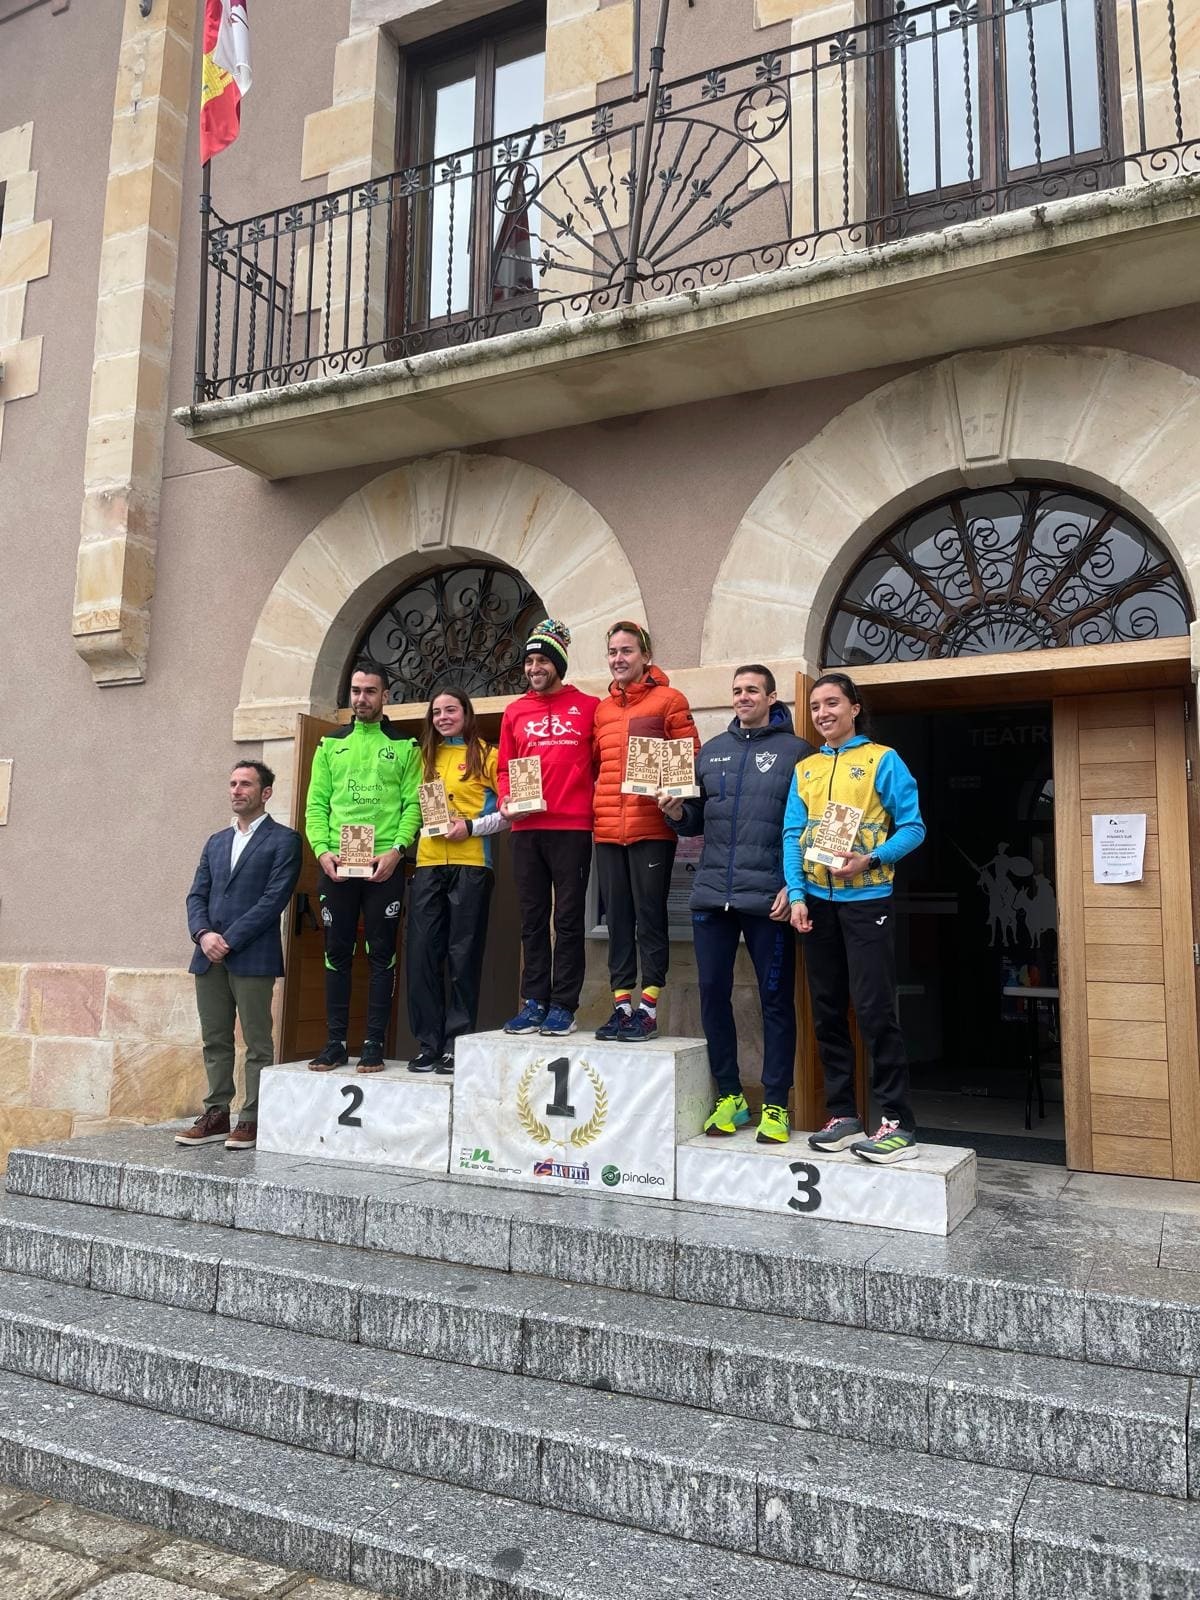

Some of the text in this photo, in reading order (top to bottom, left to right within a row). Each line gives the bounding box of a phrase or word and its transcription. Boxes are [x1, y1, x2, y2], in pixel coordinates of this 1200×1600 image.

[968, 725, 1053, 746] TEATR
[510, 761, 518, 797] RIATLON
[627, 737, 637, 781] TRIATLON
[661, 742, 669, 787] TRIATLON
[348, 779, 382, 792] Roberto
[813, 803, 835, 848] TRIATLON
[338, 1085, 363, 1127] 2
[546, 1057, 575, 1117] 1
[622, 1171, 665, 1185] pinalea
[787, 1162, 821, 1212] 3
